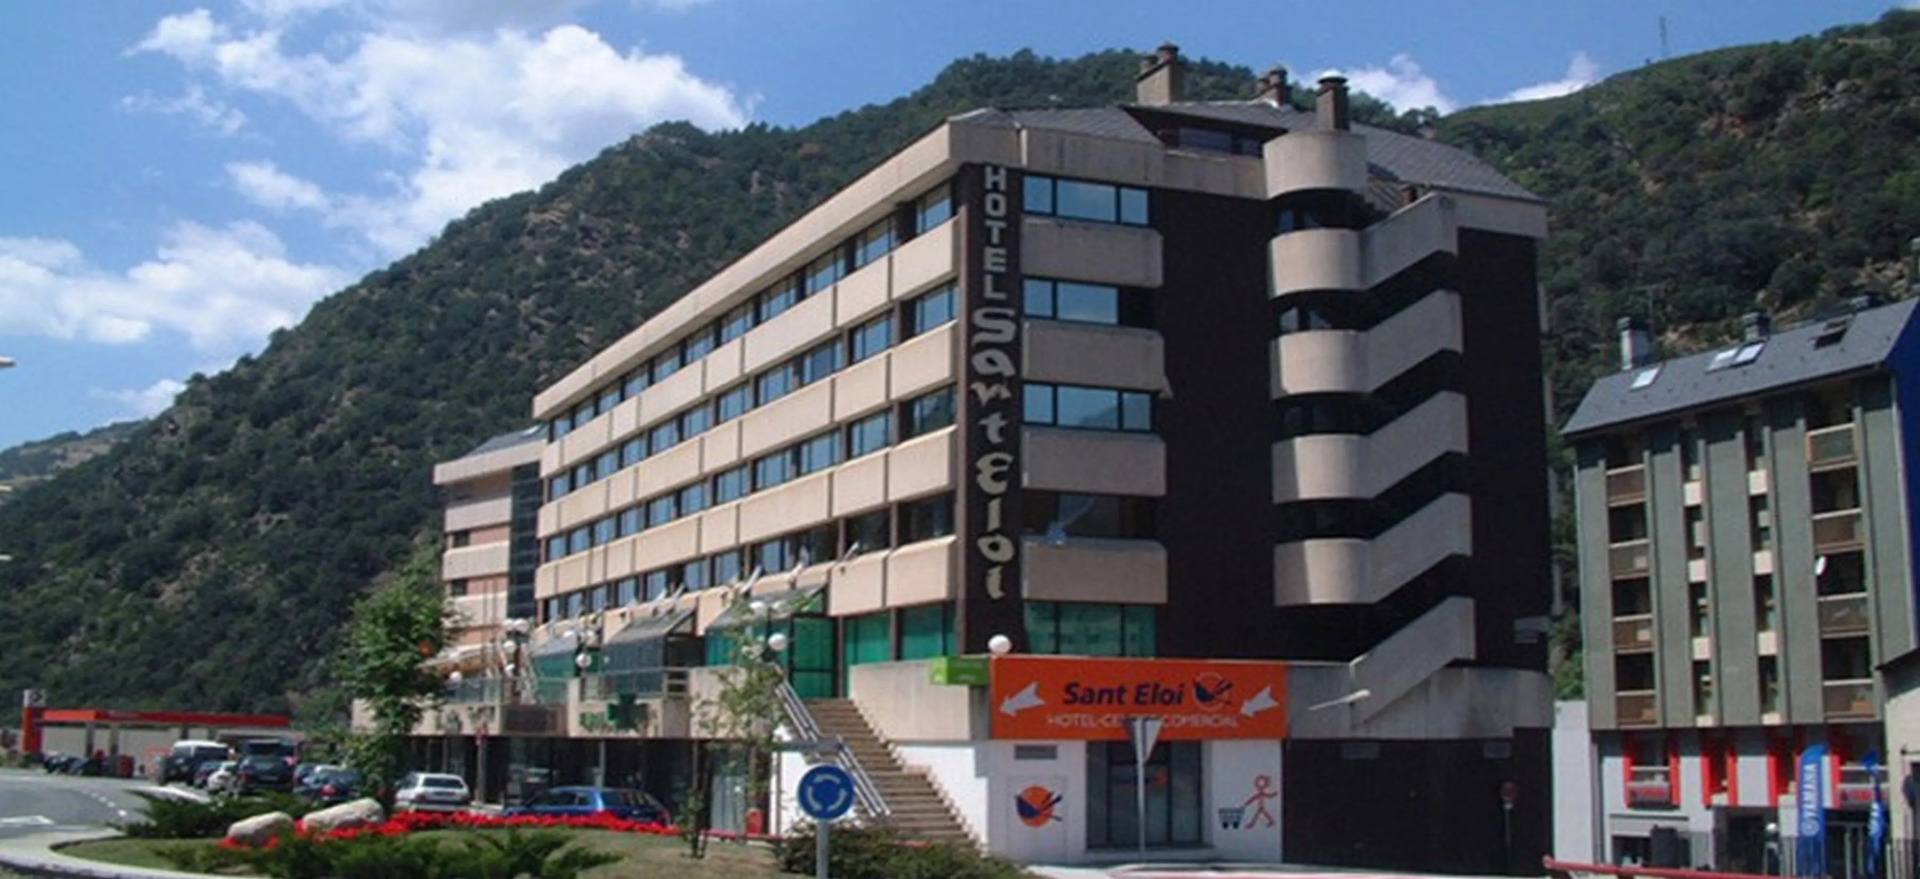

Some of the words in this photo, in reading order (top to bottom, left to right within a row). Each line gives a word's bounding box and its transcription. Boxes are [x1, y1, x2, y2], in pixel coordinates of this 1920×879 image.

[984, 165, 1007, 300] HOTEL
[970, 307, 1017, 444] Sant
[975, 452, 1016, 600] Eloi
[1063, 682, 1127, 705] Sant
[1134, 683, 1185, 705] Eloi
[1803, 763, 1817, 820] YAMAHA
